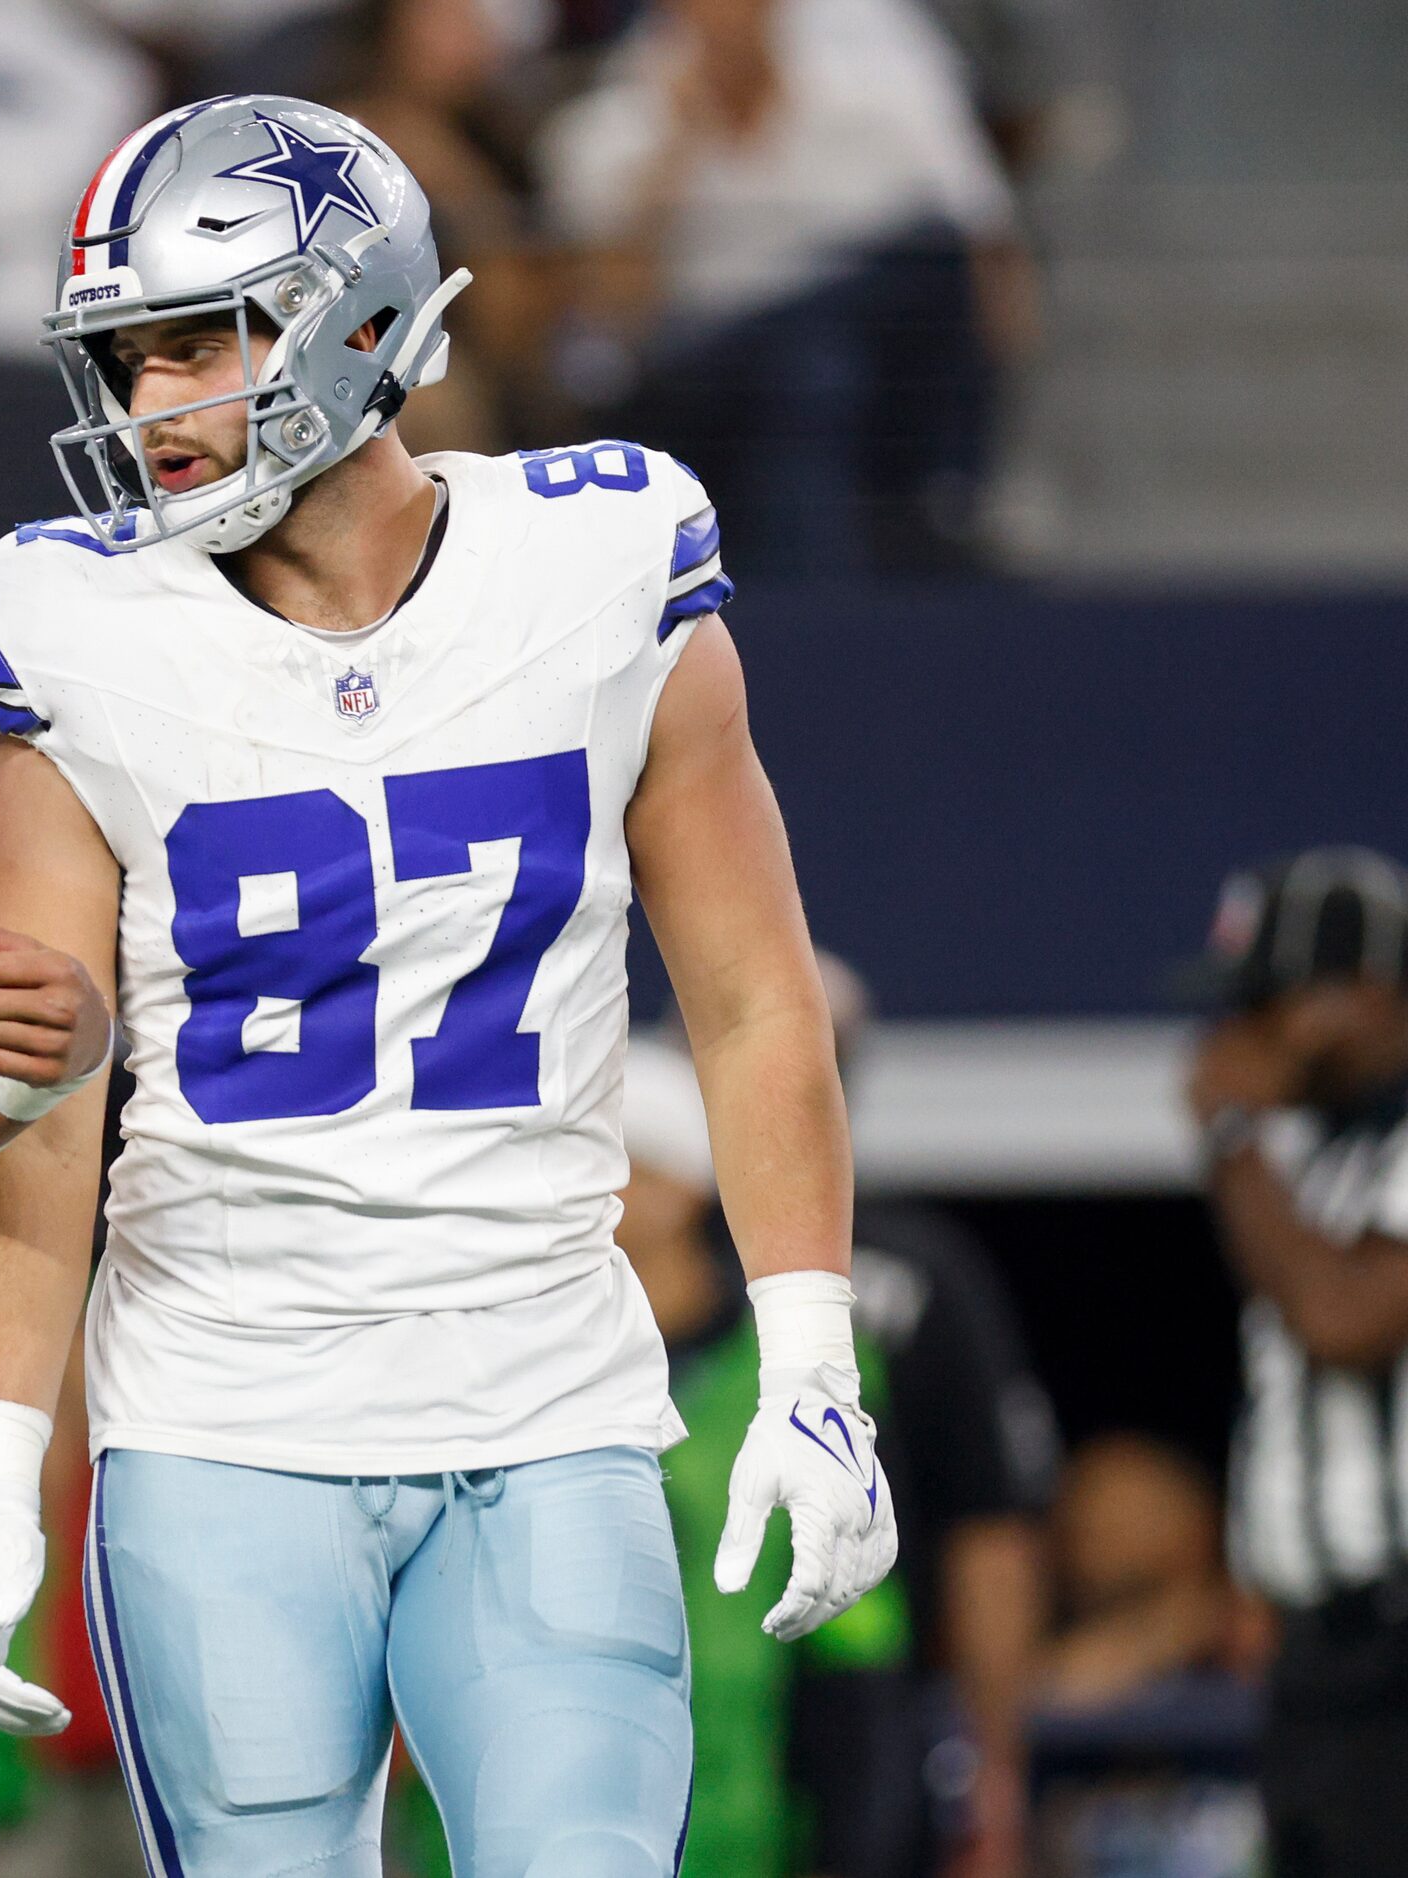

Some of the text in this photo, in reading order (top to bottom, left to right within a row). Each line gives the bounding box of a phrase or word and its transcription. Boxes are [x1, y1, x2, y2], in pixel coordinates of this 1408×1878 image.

[69, 284, 121, 306] COWBOYS
[517, 440, 650, 498] 8
[340, 691, 373, 713] NFL
[164, 747, 591, 1124] 87
